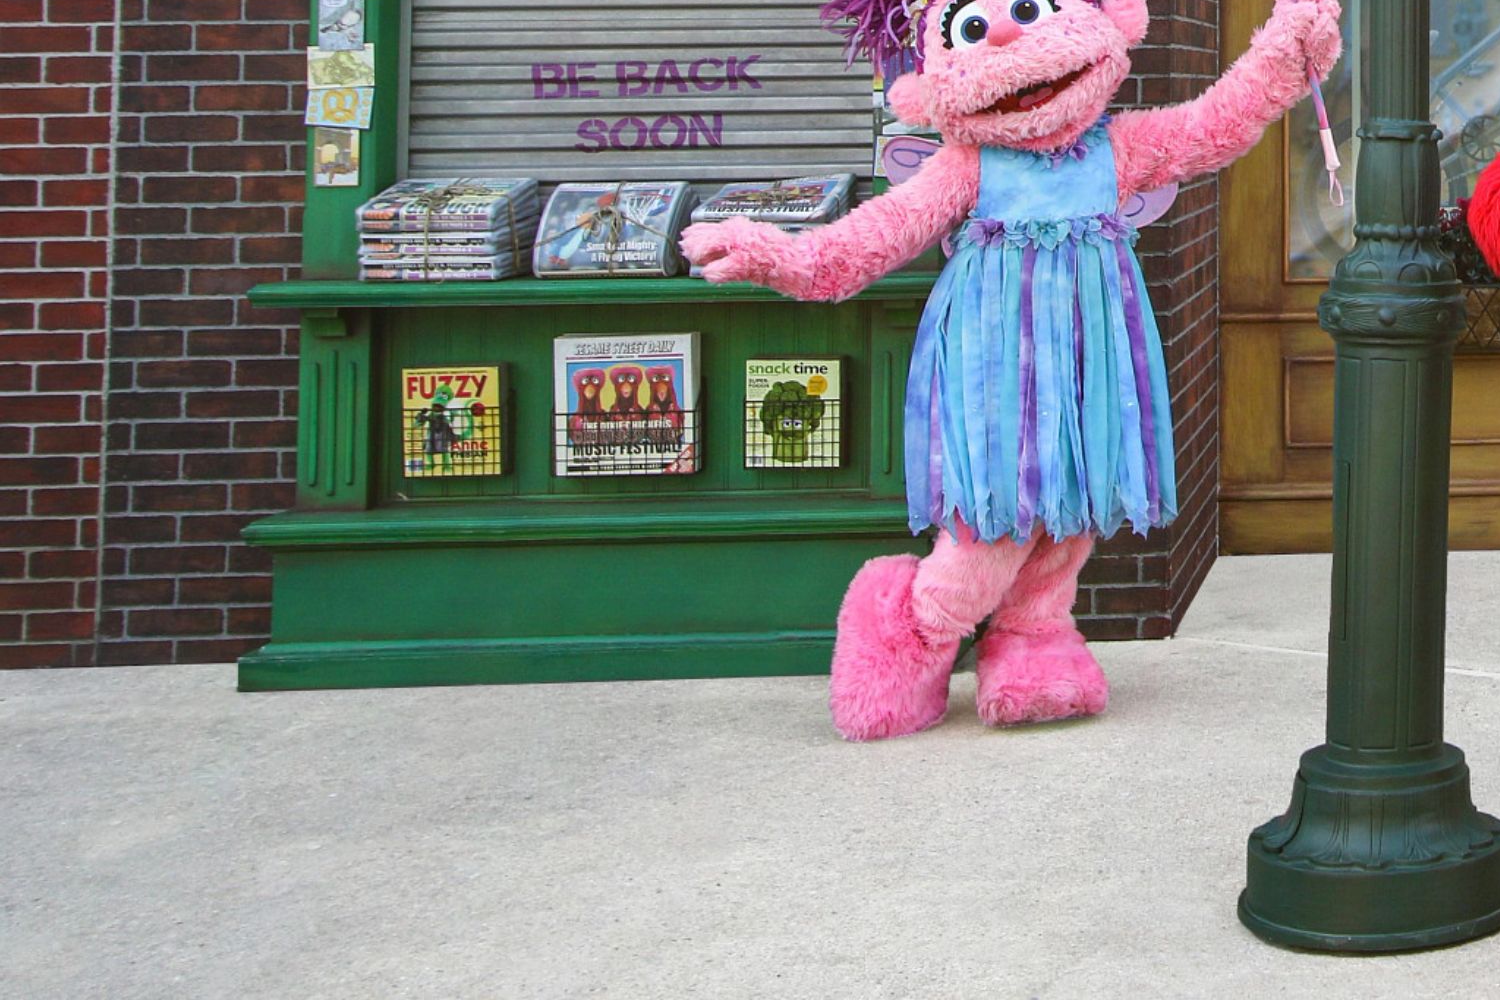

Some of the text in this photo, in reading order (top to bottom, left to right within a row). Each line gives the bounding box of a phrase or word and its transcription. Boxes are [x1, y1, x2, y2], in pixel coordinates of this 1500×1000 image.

[531, 54, 764, 100] BE BACK
[574, 112, 725, 154] SOON
[748, 362, 828, 375] snack time
[406, 374, 488, 400] FUZZY
